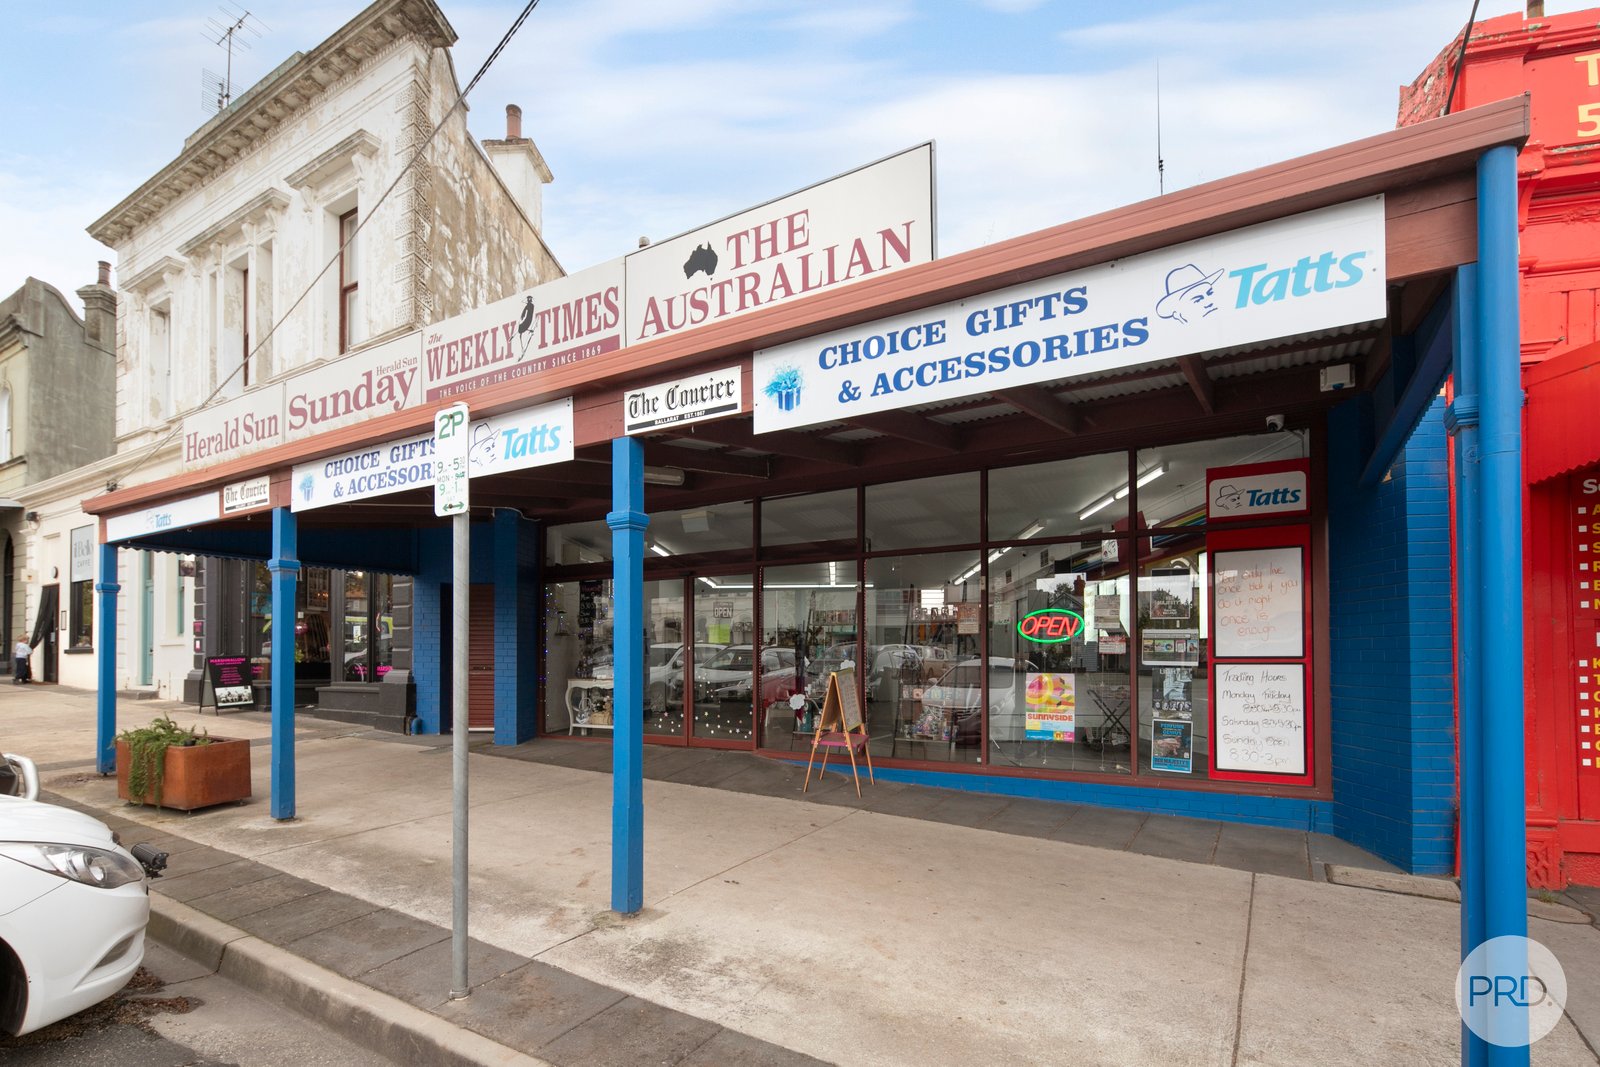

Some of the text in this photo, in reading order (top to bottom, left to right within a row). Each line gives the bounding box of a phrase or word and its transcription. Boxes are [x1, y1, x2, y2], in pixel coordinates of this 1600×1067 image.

[726, 209, 810, 271] THE
[636, 220, 915, 341] AUSTRALIAN
[1229, 251, 1367, 309] Tatts
[426, 286, 620, 382] WEEKLY TIMES
[428, 333, 442, 344] The
[818, 286, 1088, 370] CHOICE GIFTS
[376, 356, 418, 376] Herald Sun
[439, 345, 602, 399] THE VOICE OF THE COUNTRY SINCE 1869
[838, 317, 1149, 403] & ACCESSORIES
[289, 367, 417, 431] Sunday
[628, 377, 735, 419] The Courier
[185, 412, 279, 463] Herald Sun
[438, 410, 464, 440] 2P
[501, 423, 562, 460] Tatts
[324, 447, 381, 479] CHOICE
[333, 461, 435, 499] & ACCESSOR
[225, 481, 268, 503] The Courier
[1246, 487, 1301, 507] Tatts
[155, 513, 172, 528] Tatts
[714, 607, 732, 617] OPEN
[1021, 616, 1079, 637] OPEN
[1222, 689, 1256, 704] Monday
